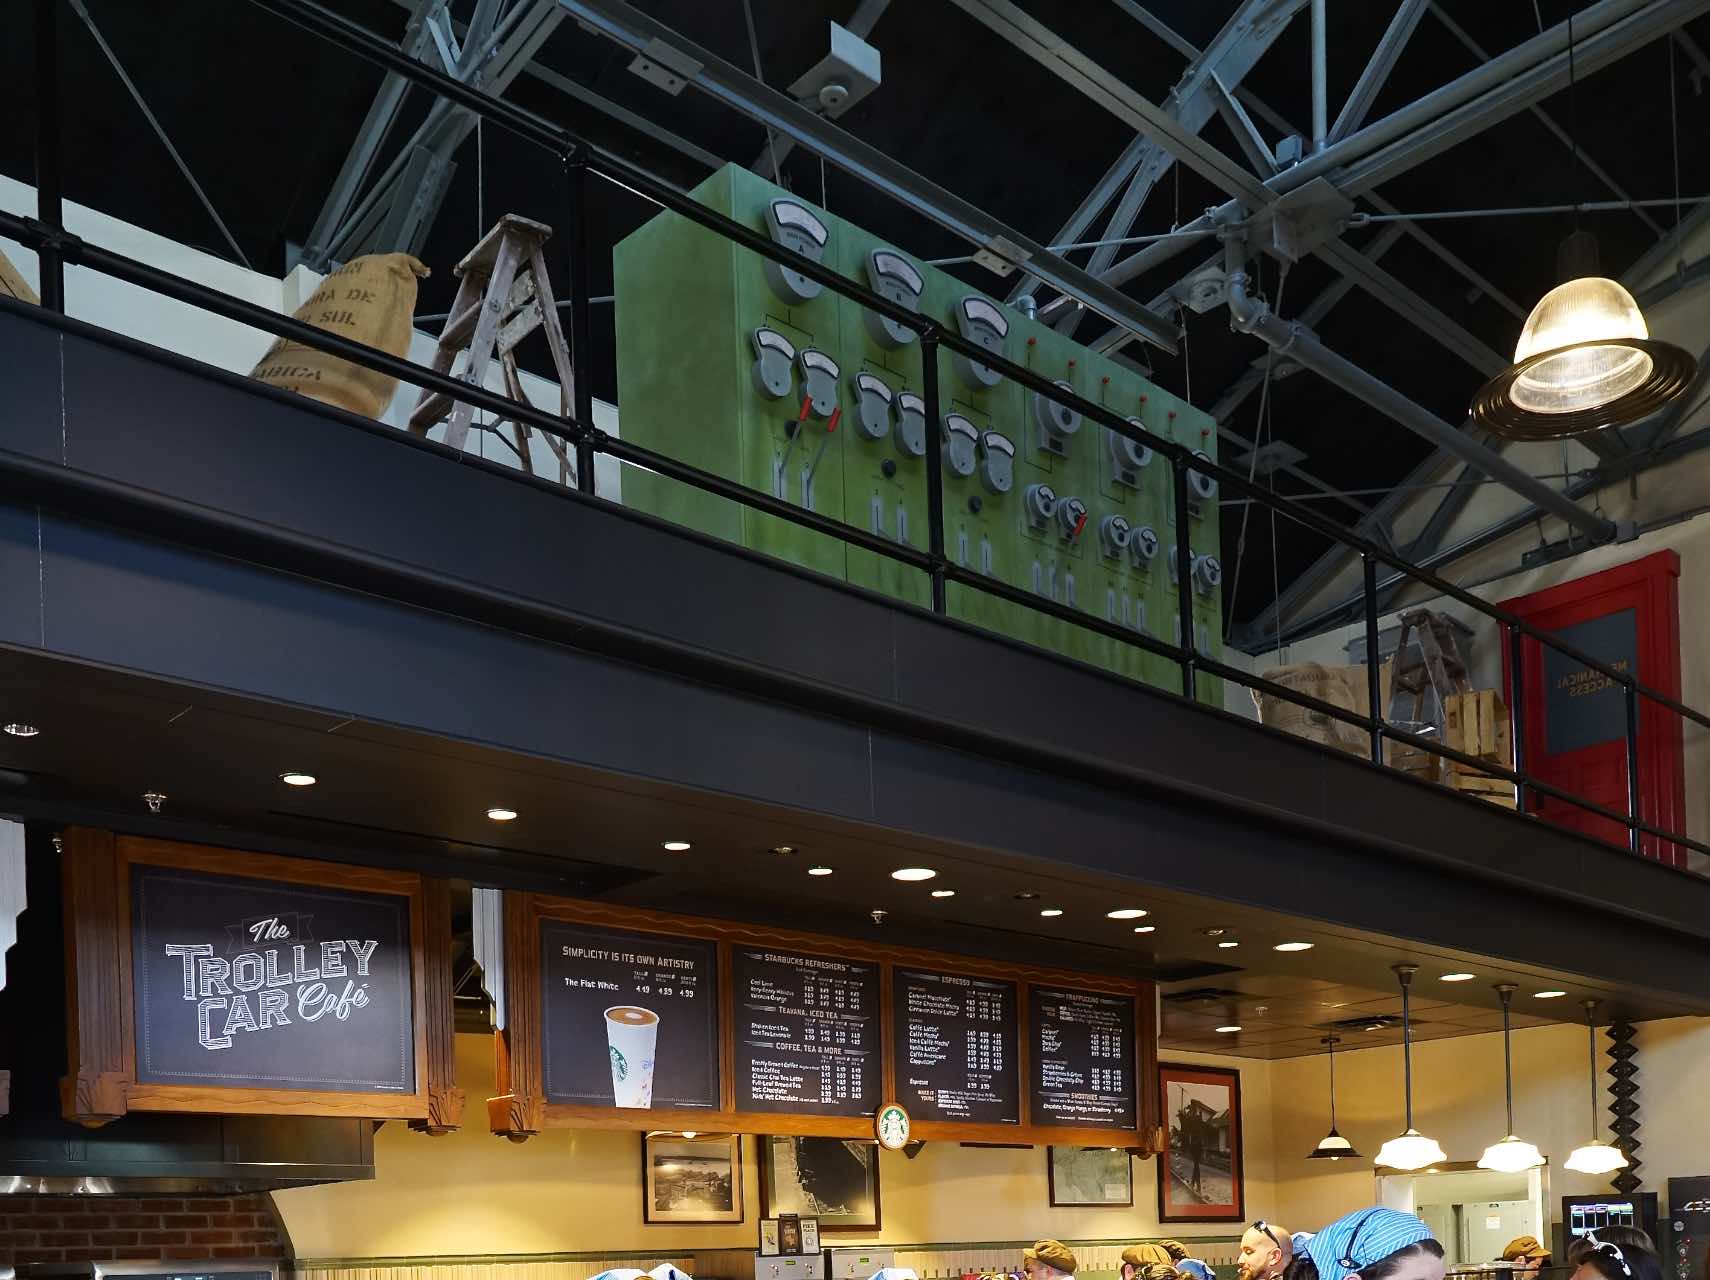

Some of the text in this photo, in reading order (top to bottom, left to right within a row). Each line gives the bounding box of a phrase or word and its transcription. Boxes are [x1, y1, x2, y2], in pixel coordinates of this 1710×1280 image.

[249, 917, 290, 943] The
[562, 946, 695, 970] SIMPLICITY IS ITS OWN ARTISTRY
[764, 954, 804, 966] STARBUCKS
[165, 940, 379, 1001] TROLLEY
[565, 977, 579, 987] The
[580, 979, 597, 989] Flat
[597, 981, 620, 992] White
[198, 981, 371, 1050] CAR Café
[809, 1008, 825, 1018] ICED
[825, 1010, 838, 1019] TEA
[804, 1044, 817, 1053] TEA
[824, 1046, 842, 1055] MORE
[764, 1067, 780, 1075] Coffee
[762, 1087, 787, 1095] Chocolate
[774, 1094, 799, 1102] Chocolate
